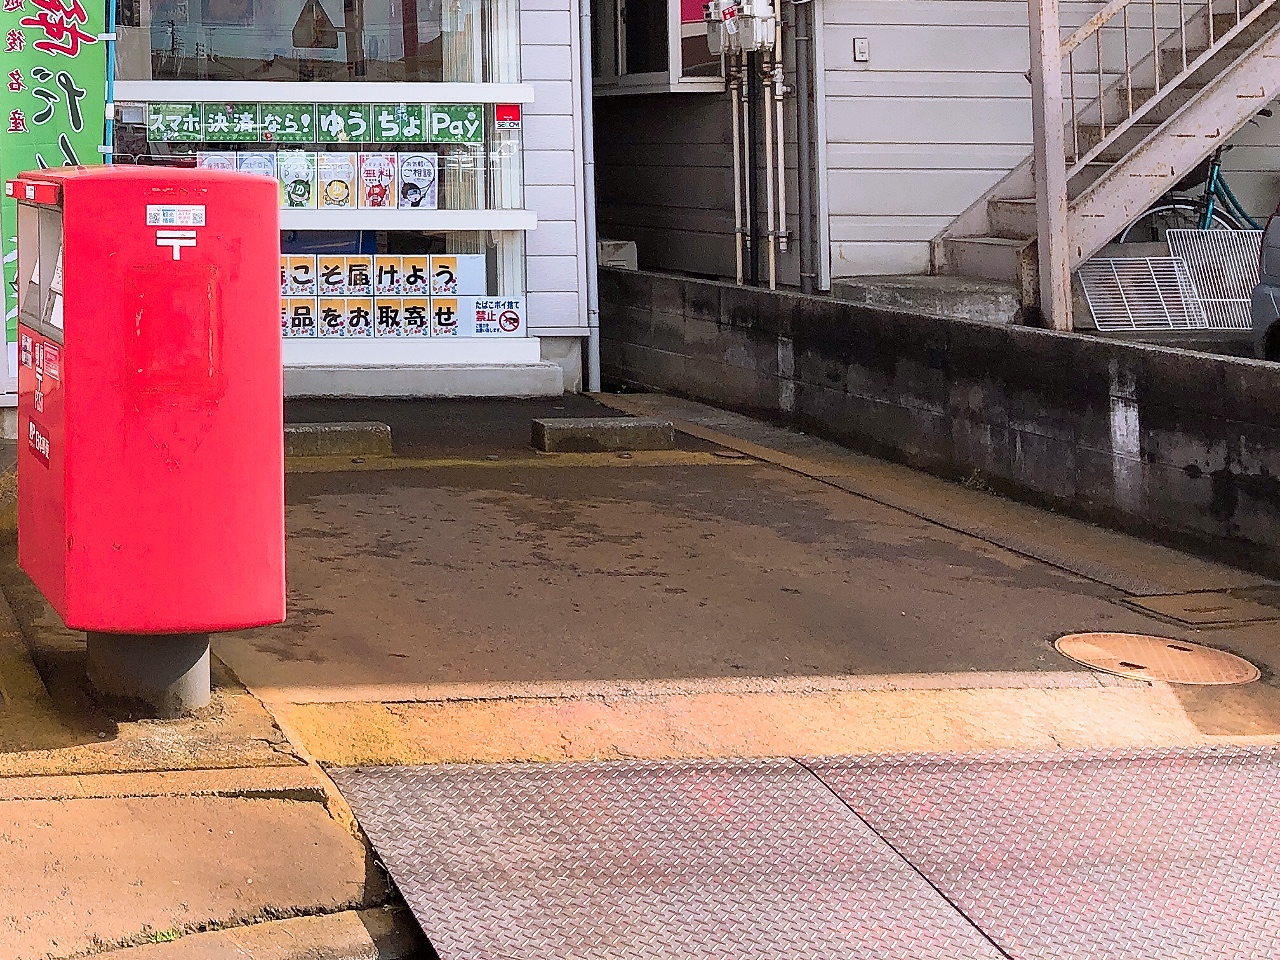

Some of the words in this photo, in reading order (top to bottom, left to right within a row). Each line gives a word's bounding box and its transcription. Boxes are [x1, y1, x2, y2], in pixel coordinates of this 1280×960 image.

[496, 121, 521, 129] SECOM
[281, 264, 454, 287] こそ届けよう
[475, 300, 520, 310] たばこポイ捨て
[281, 305, 454, 328] 品をお取寄せ
[475, 310, 497, 322] 禁止
